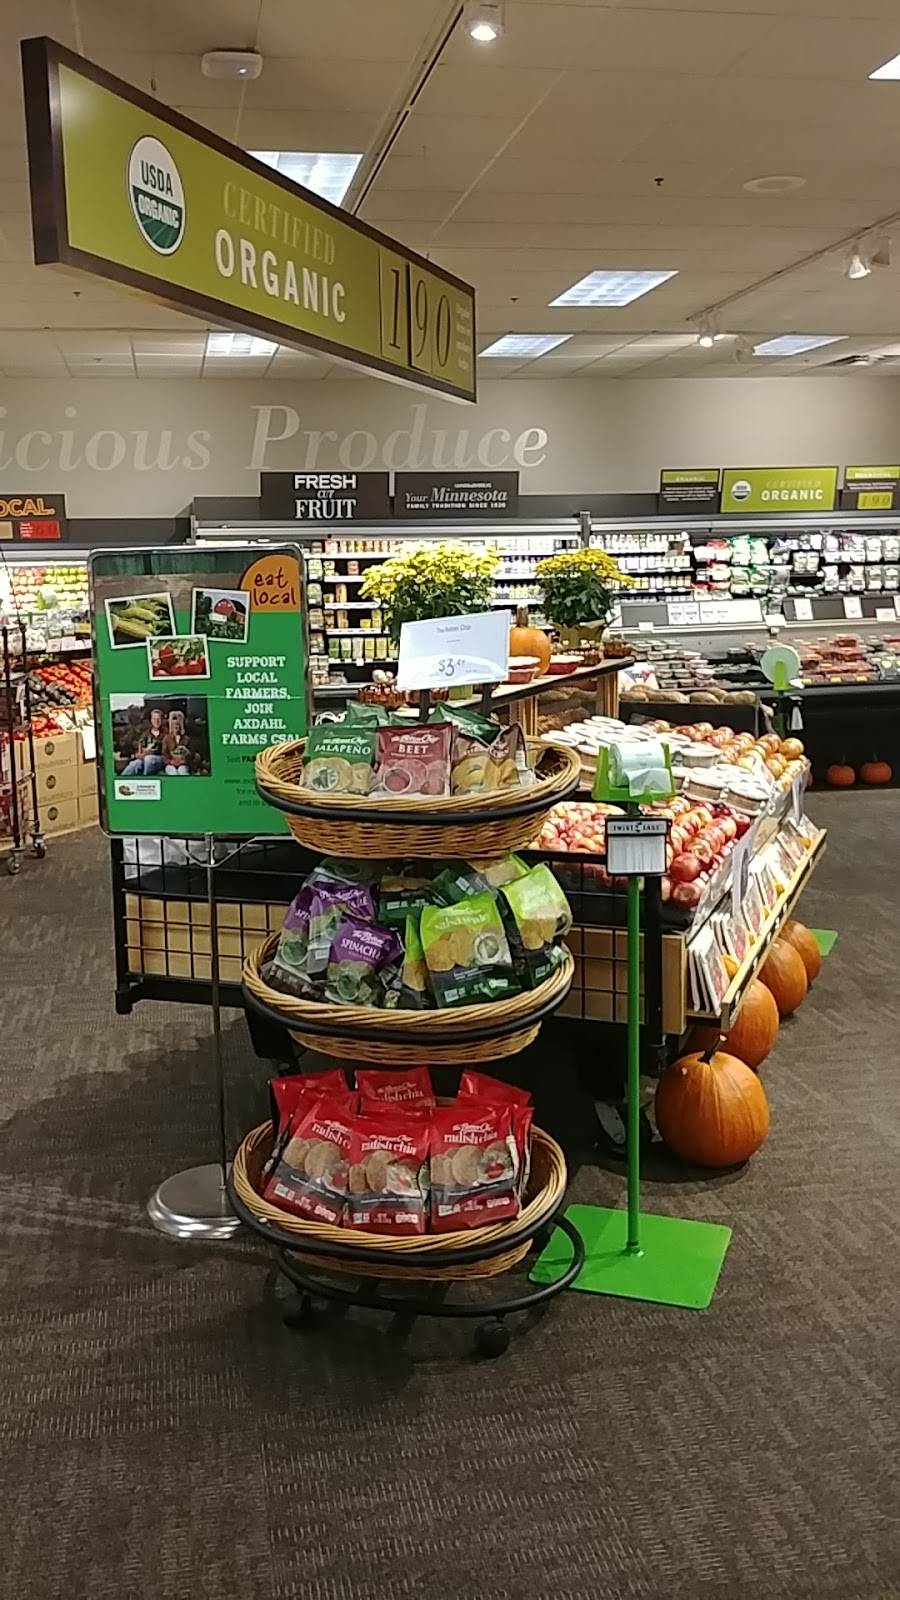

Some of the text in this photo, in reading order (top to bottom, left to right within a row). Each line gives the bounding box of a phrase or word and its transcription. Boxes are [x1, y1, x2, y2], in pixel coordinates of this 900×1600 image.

[141, 159, 174, 198] USDA
[137, 193, 180, 229] ORGANIC
[223, 181, 336, 265] CERTIFIED
[215, 229, 346, 323] ORGANIC
[244, 403, 549, 471] Produce
[294, 474, 357, 490] FRESH
[405, 487, 508, 503] Your Minnesota
[760, 489, 824, 501] ORGANIC
[294, 498, 357, 519] FRUIT
[254, 566, 289, 589] eat
[253, 587, 297, 606] local
[226, 655, 287, 668] SUPPORT
[236, 671, 278, 683] LOCAL
[225, 688, 291, 700] FARMERS,
[244, 703, 274, 714] JOIN
[233, 718, 287, 729] AXDAHL
[222, 734, 268, 745] FARMS
[398, 744, 430, 754] BEET
[341, 937, 377, 958] SPINACH
